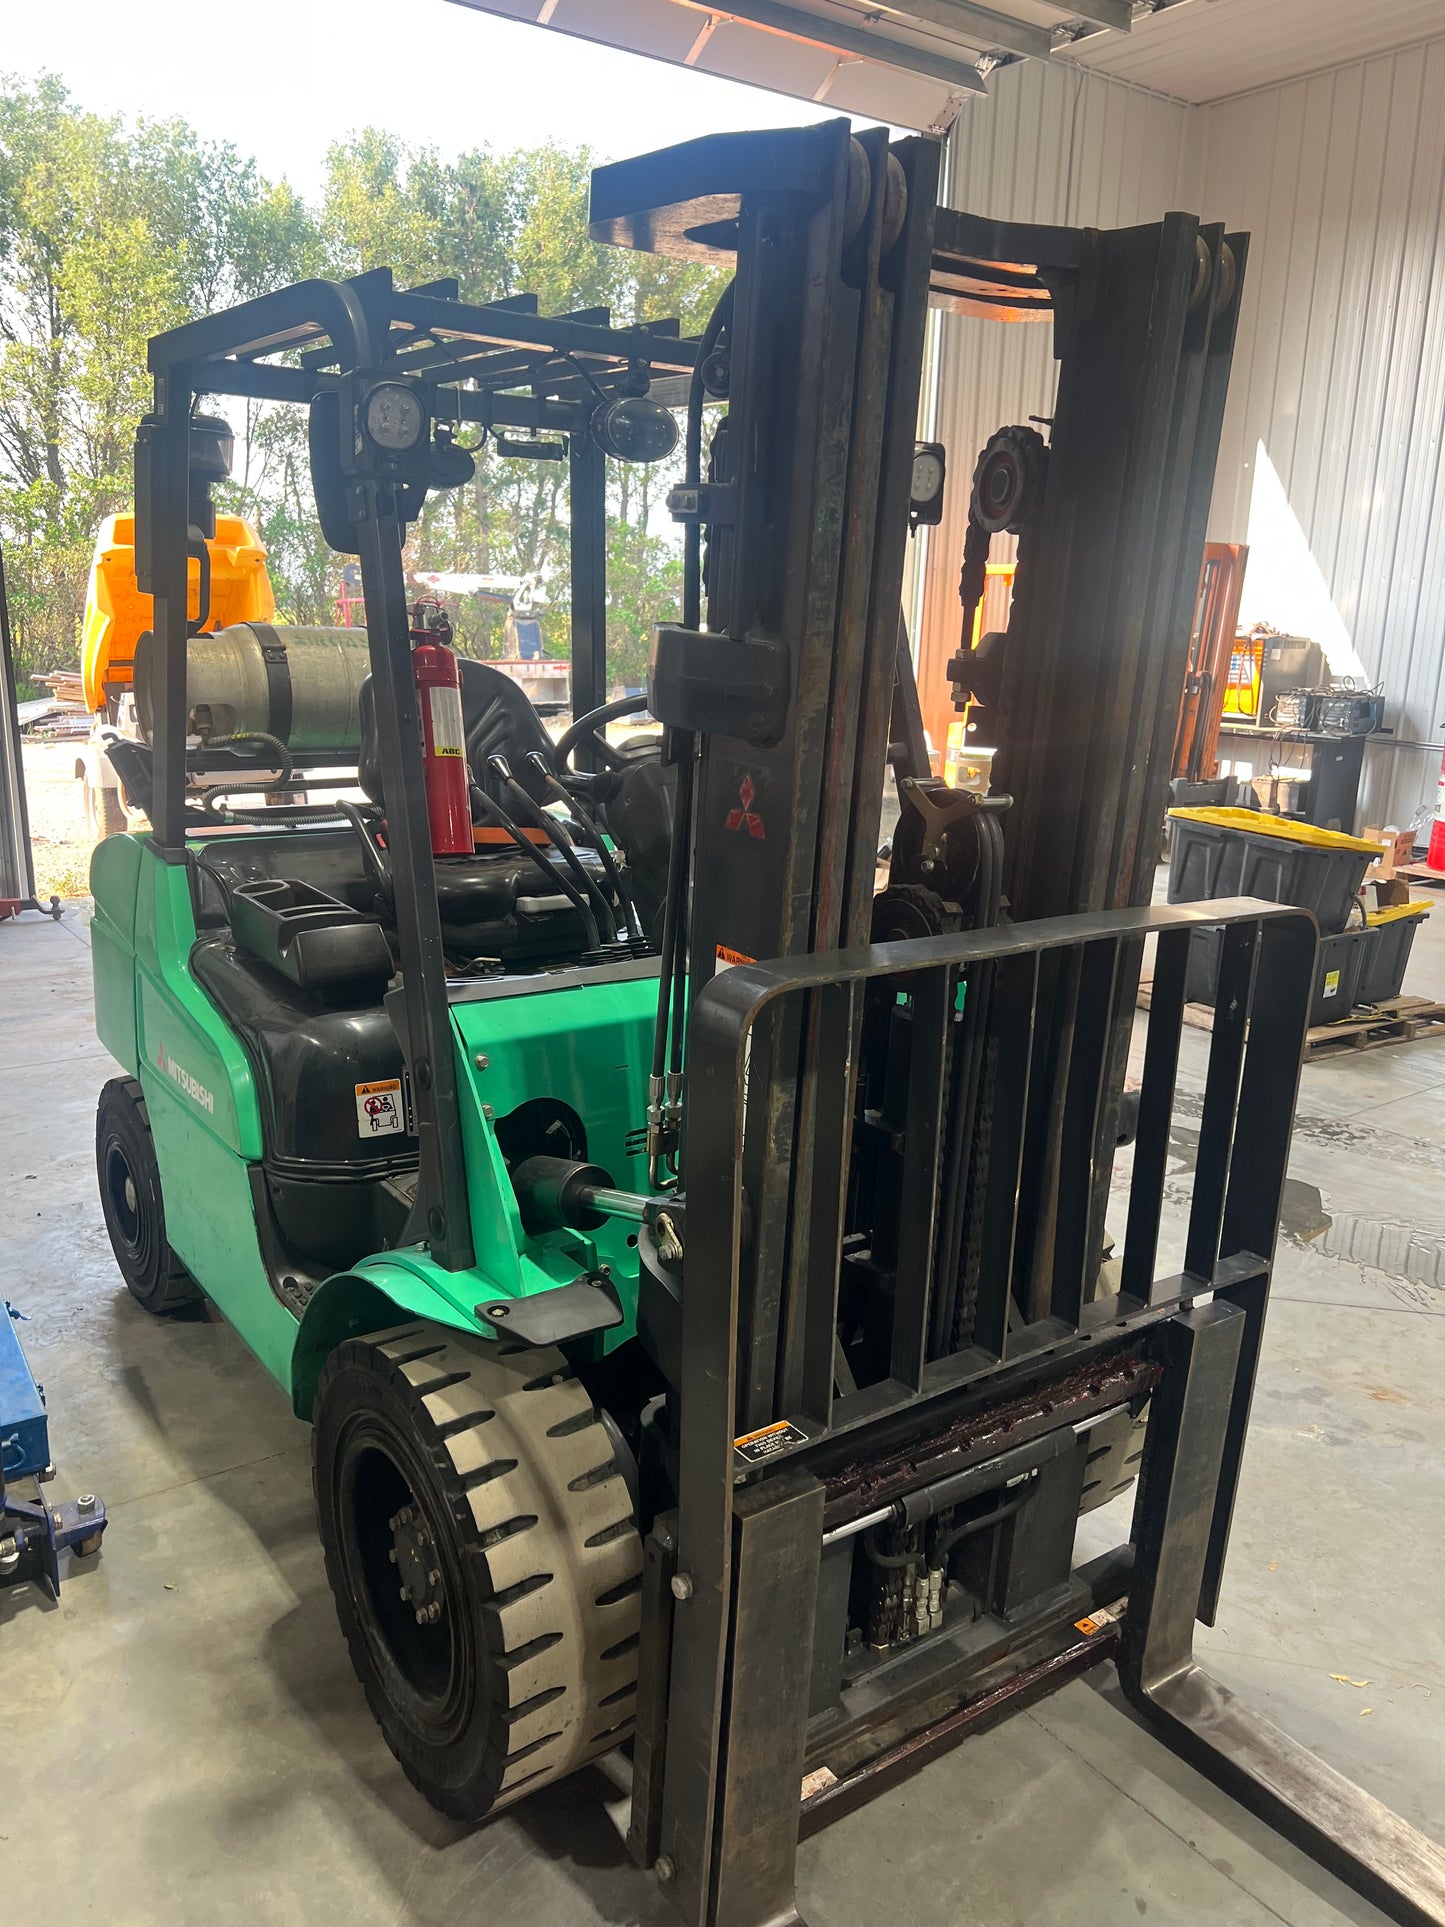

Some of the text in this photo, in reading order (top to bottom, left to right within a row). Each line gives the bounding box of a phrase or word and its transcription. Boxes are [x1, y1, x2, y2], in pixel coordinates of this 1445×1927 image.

[441, 748, 460, 756] ABC
[168, 1056, 214, 1114] MITSUBISHI
[741, 1435, 768, 1448] OPERATION
